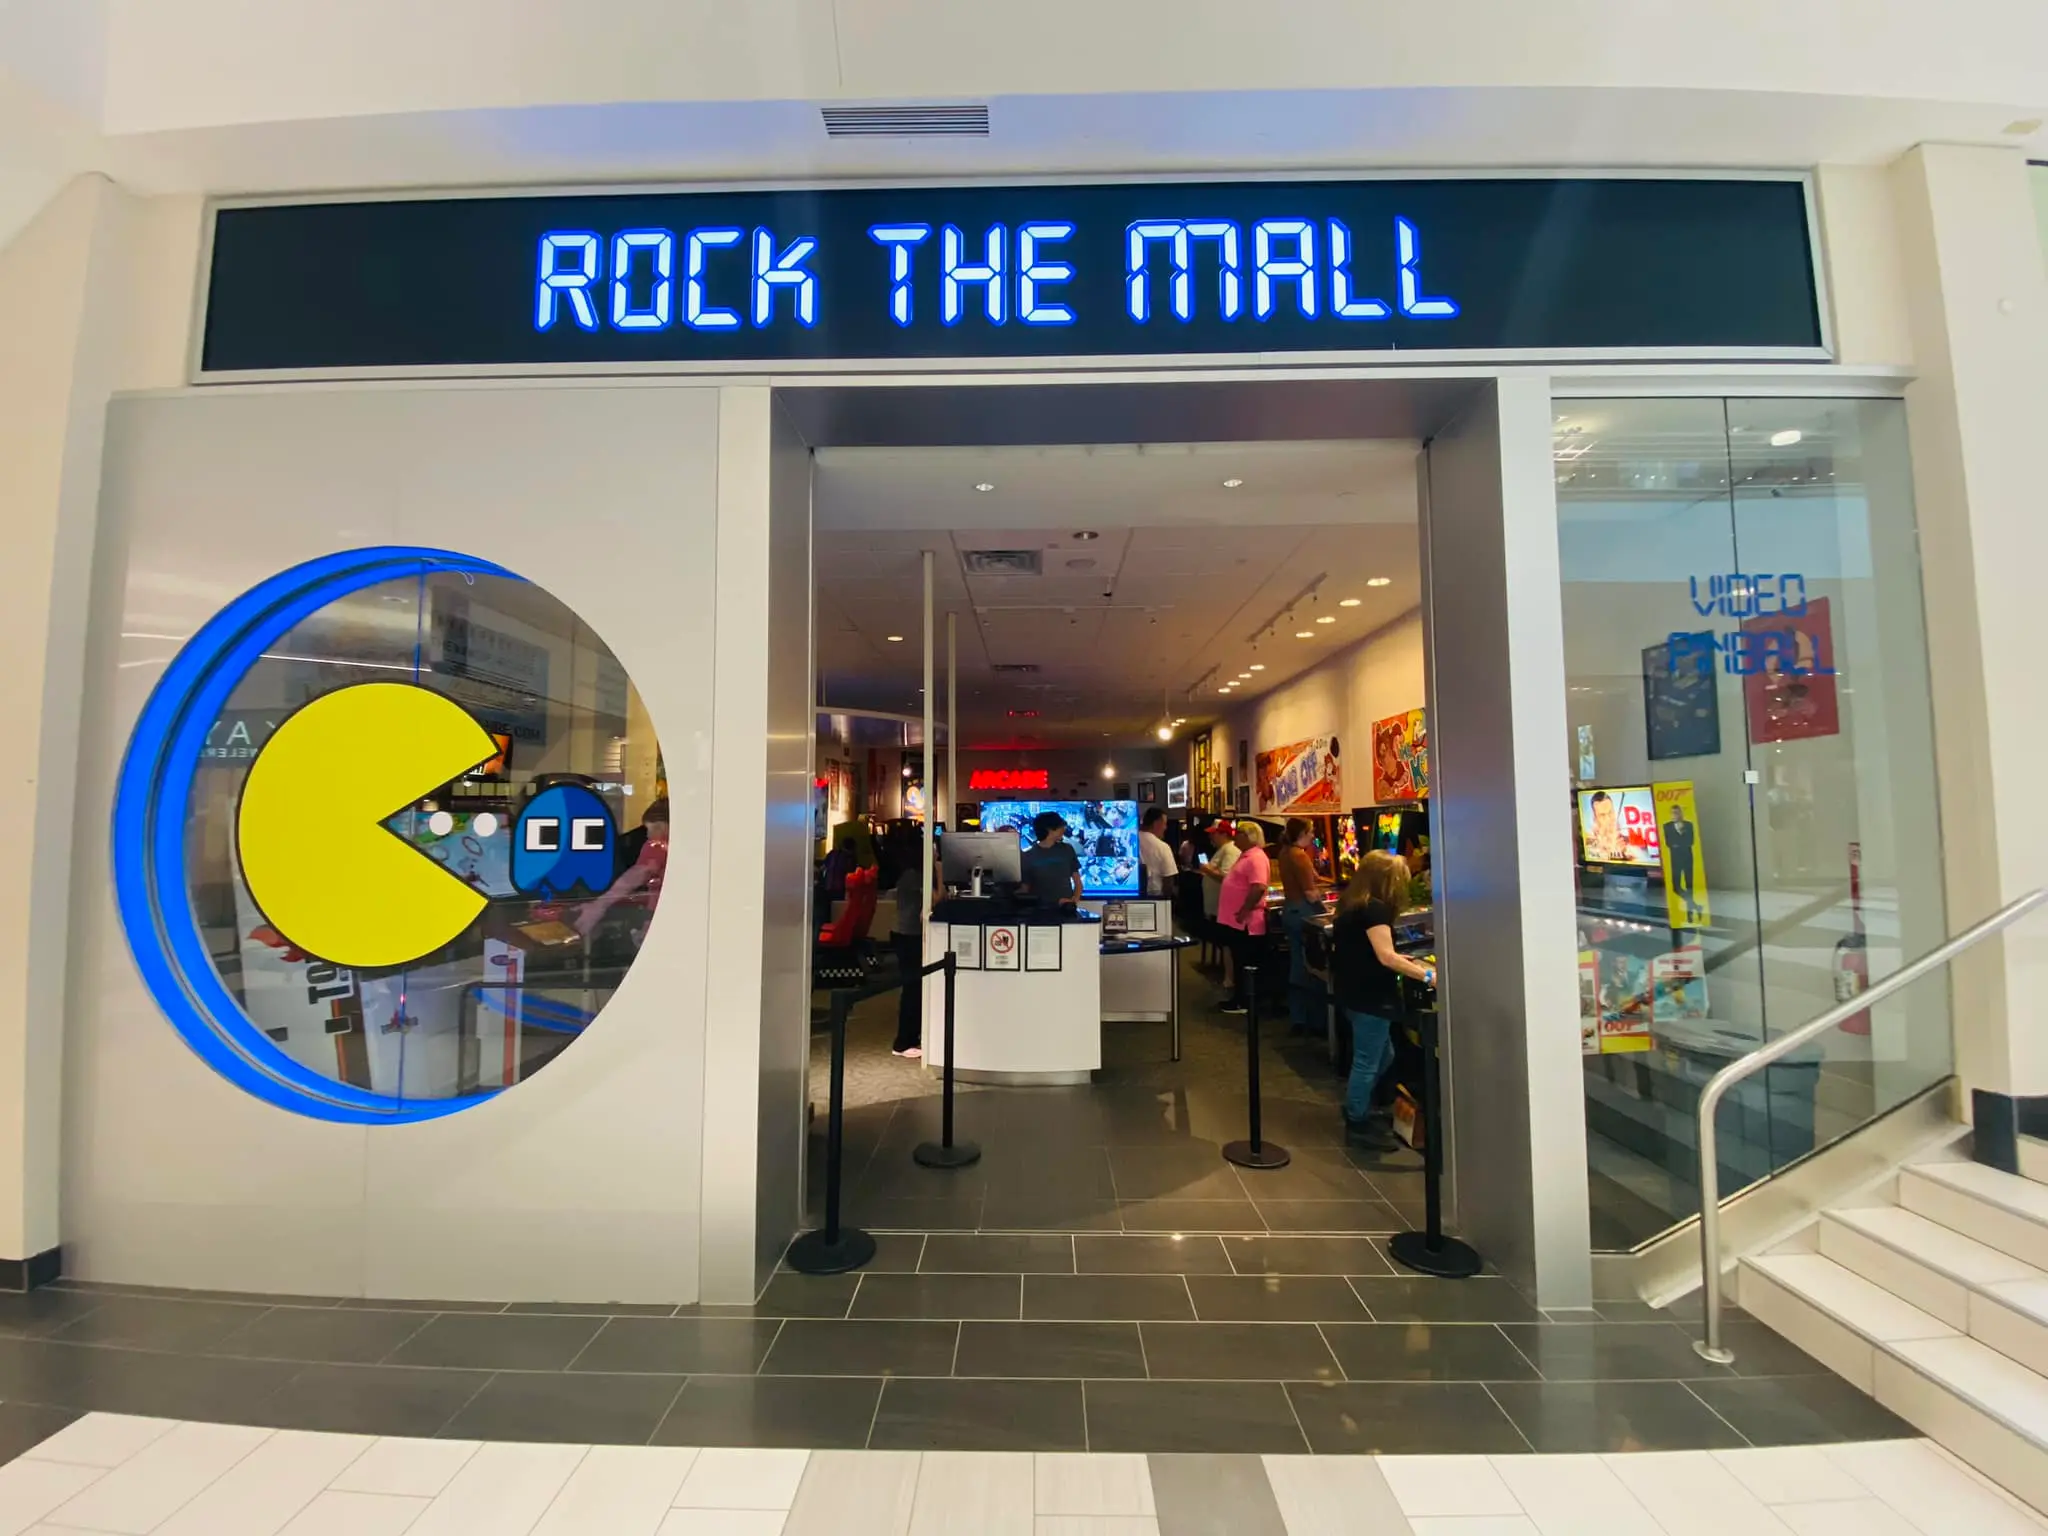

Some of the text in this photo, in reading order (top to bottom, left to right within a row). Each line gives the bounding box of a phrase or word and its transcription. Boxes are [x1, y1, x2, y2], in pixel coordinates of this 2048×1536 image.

[534, 216, 1461, 332] ROCK THE MALL
[1690, 573, 1807, 618] VIDEO
[1667, 631, 1836, 676] PINBALL
[968, 769, 1049, 791] ARCADE
